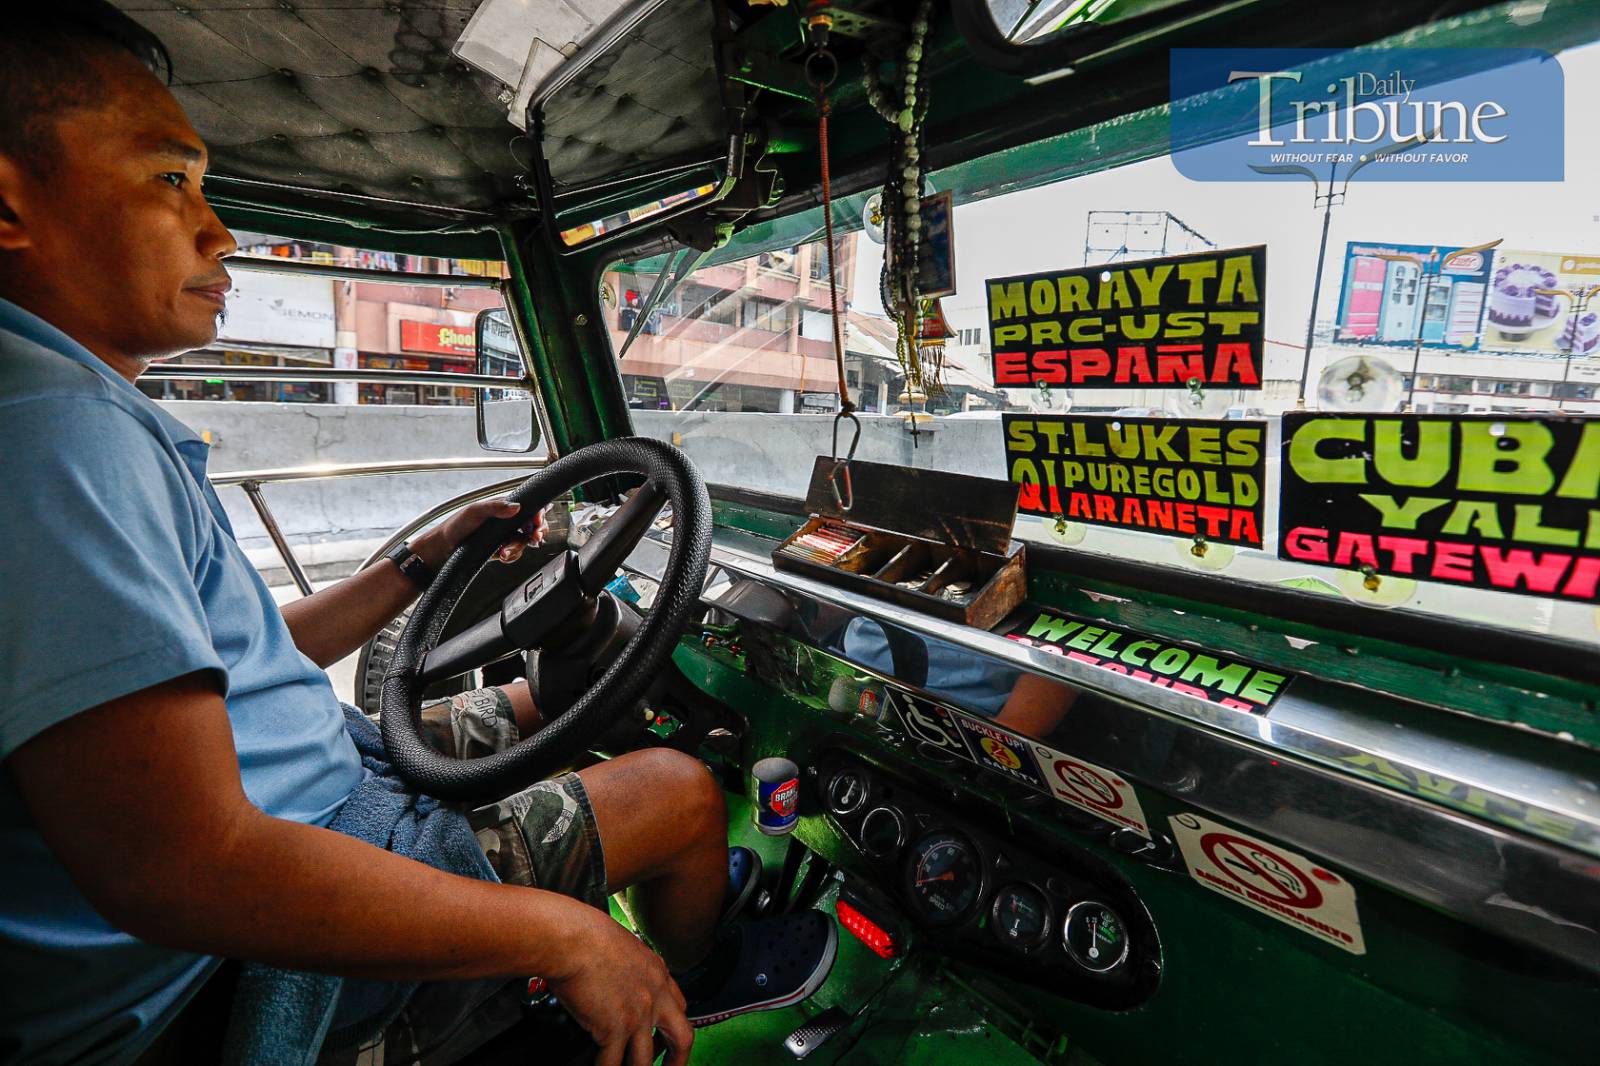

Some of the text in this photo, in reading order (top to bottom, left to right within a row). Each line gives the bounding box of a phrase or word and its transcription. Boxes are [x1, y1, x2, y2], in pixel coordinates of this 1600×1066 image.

[989, 255, 1258, 321] MORAYTA
[994, 311, 1259, 347] PRC-UST
[995, 343, 1258, 384] ESPAÑA
[1008, 420, 1260, 466] ST.LUKES
[1012, 458, 1062, 513] QI
[1063, 460, 1259, 507] PUREGOLD
[1069, 492, 1259, 543] ARANETA
[1358, 493, 1600, 549] YAL
[1026, 613, 1286, 705] WELCOME
[960, 719, 1003, 742] BUCKLE
